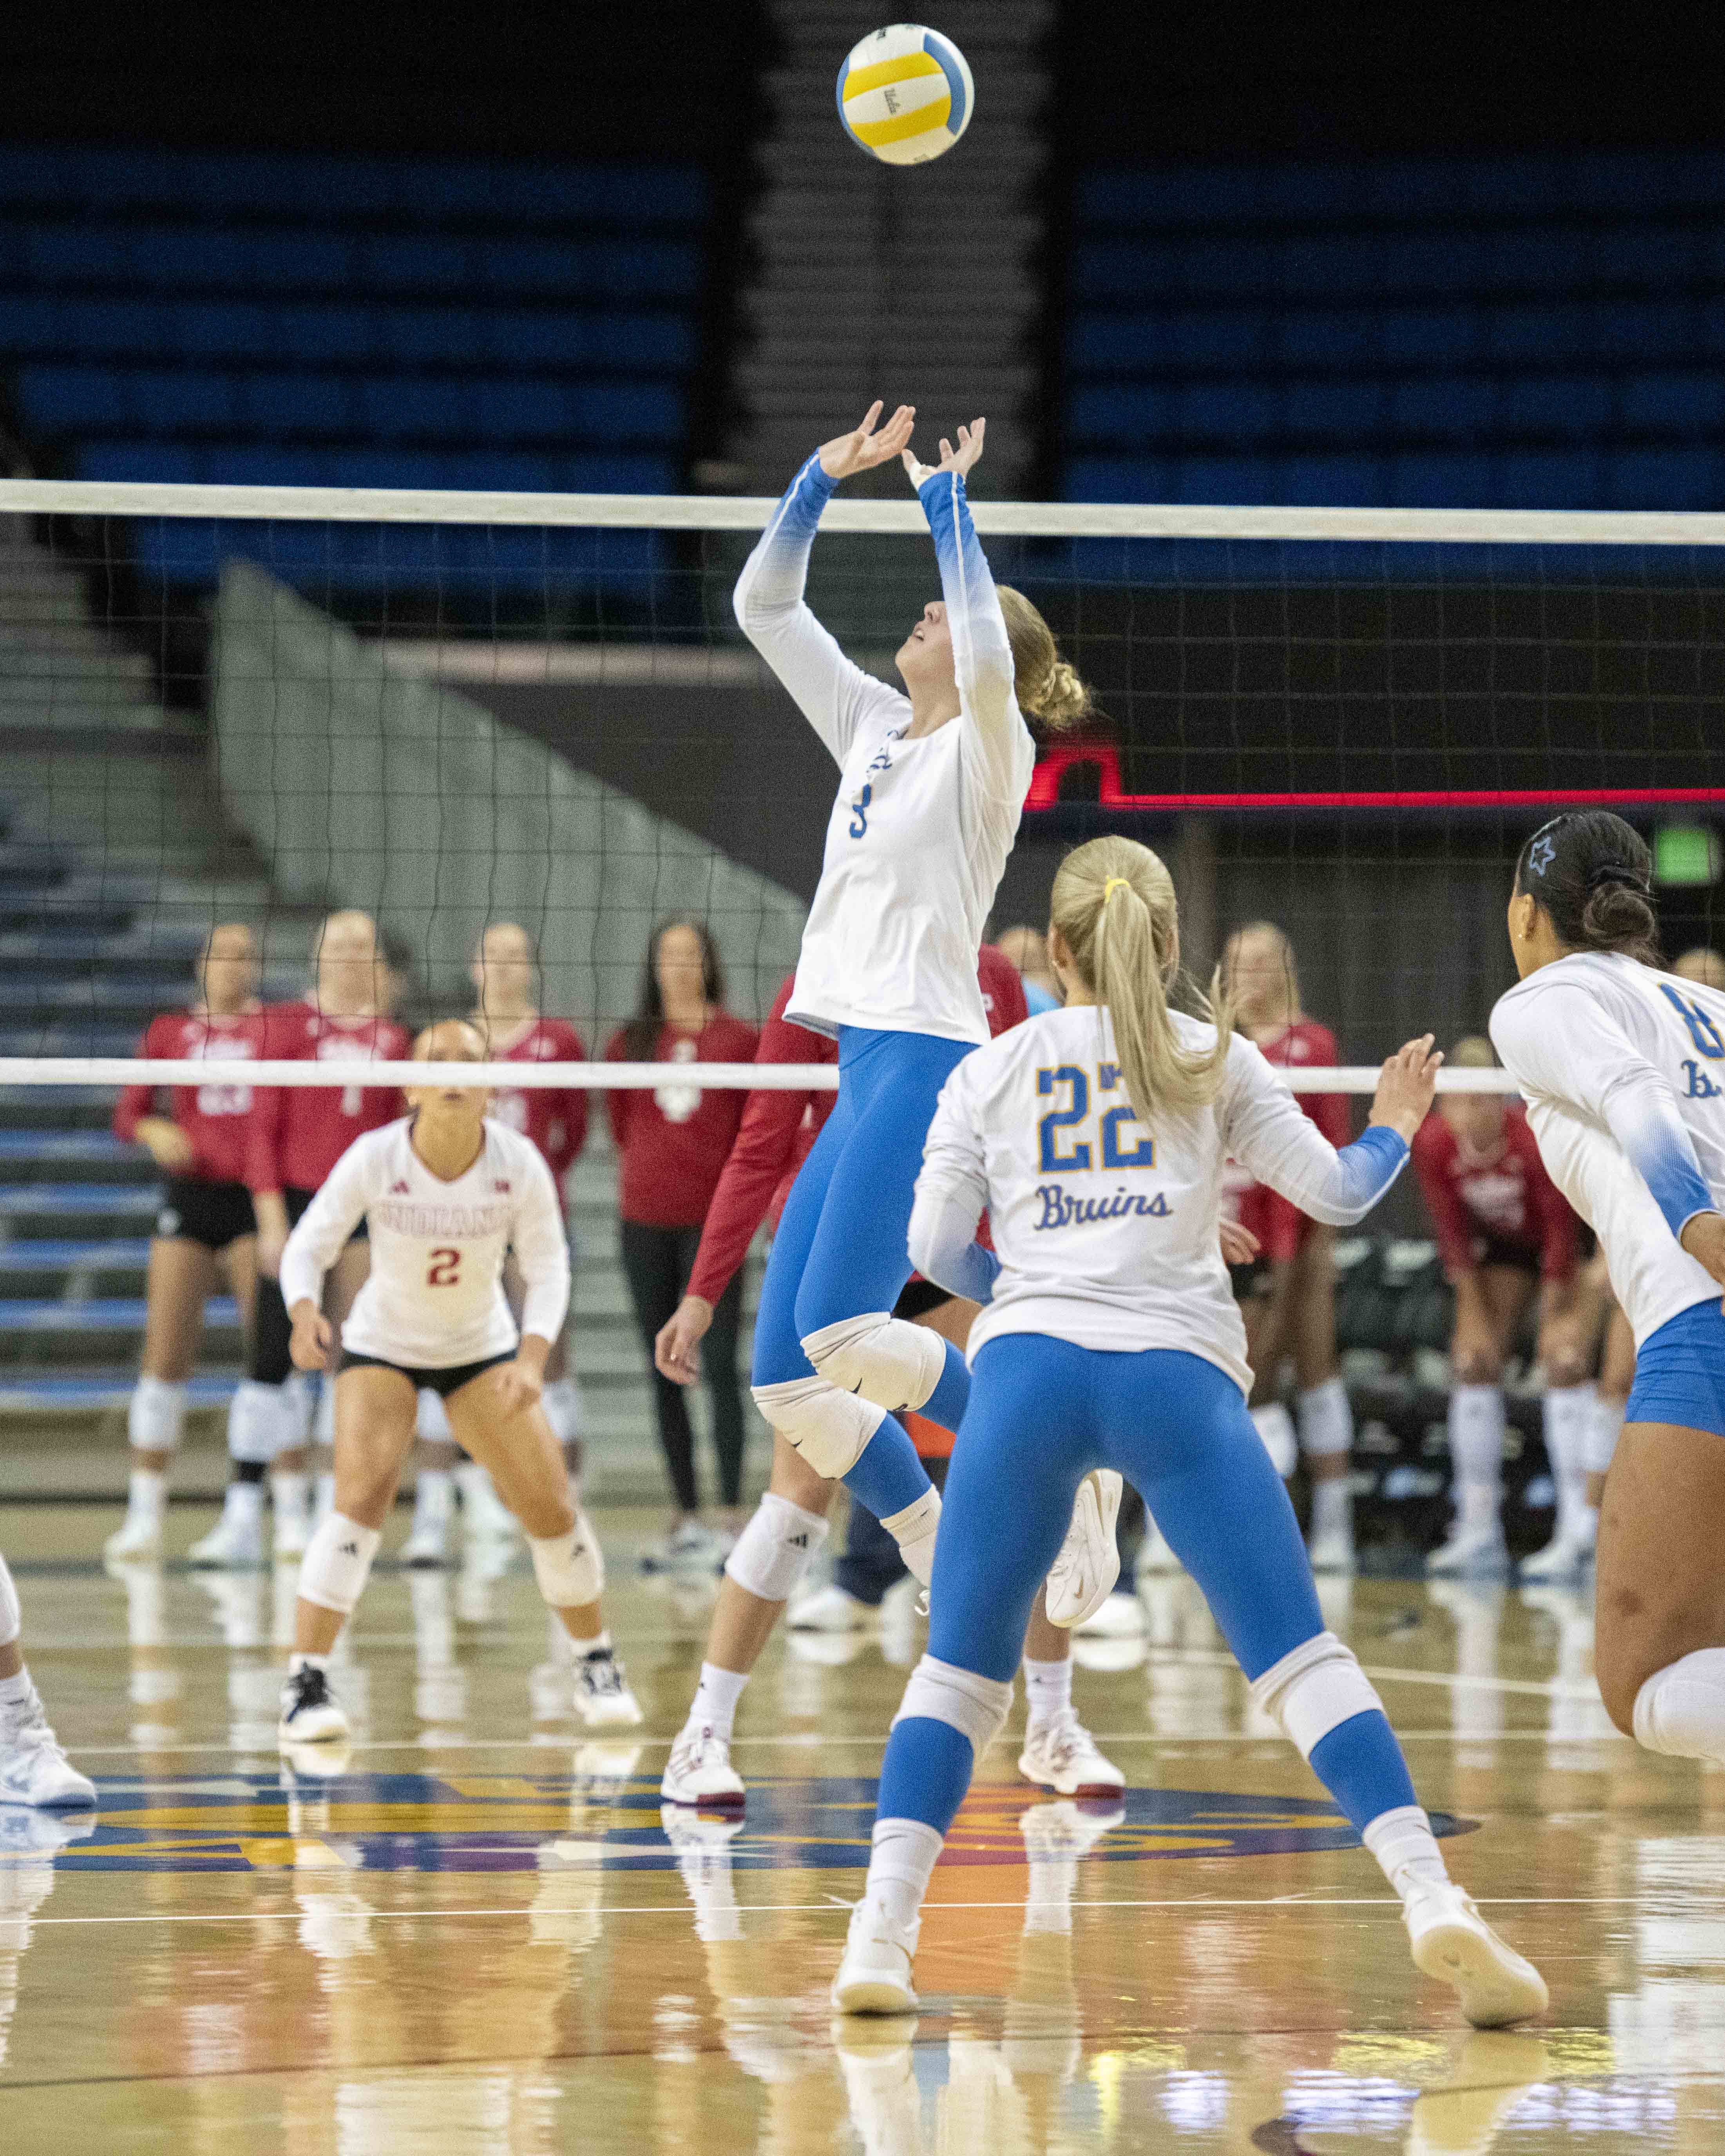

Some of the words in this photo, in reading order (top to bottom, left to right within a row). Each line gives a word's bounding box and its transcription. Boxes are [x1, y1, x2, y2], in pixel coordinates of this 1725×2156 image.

[1036, 1061, 1157, 1174] 22
[1034, 1184, 1174, 1231] Bruins
[427, 1248, 462, 1286] 2
